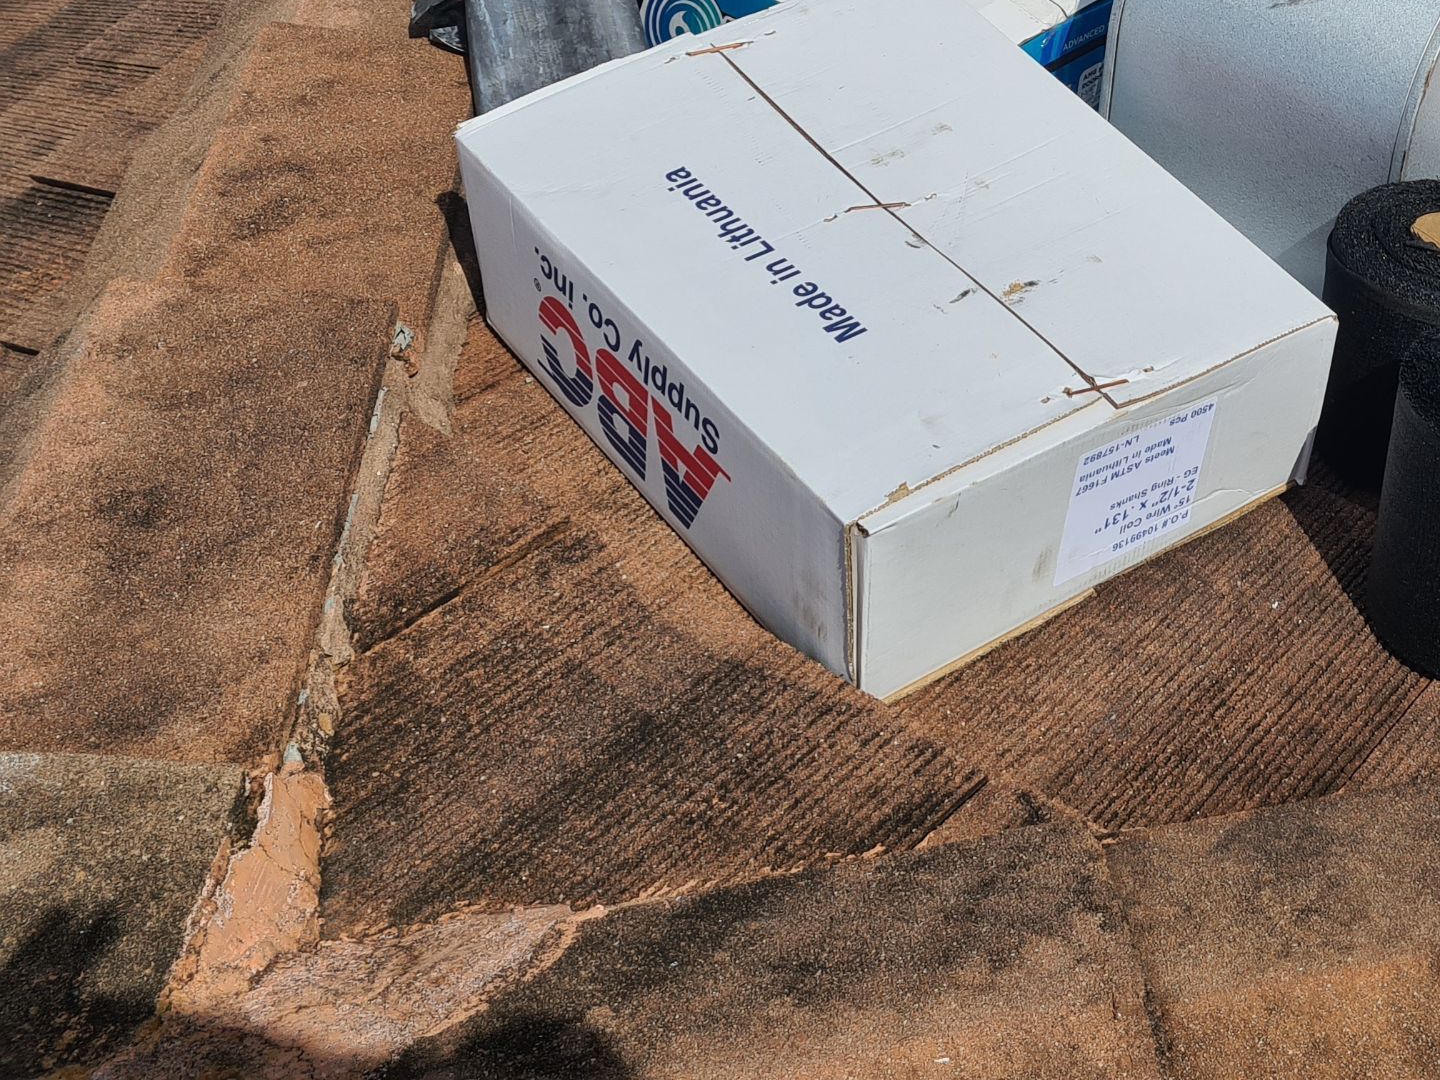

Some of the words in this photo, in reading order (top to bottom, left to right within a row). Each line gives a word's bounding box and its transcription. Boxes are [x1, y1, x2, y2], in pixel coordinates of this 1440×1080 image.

[1063, 24, 1105, 52] ADVANCED
[665, 166, 776, 262] Lithuania
[534, 246, 574, 310] inc.
[765, 257, 802, 286] in
[582, 294, 622, 353] Co.
[792, 281, 868, 344] Made
[628, 339, 721, 456] Supply
[536, 295, 732, 530] ABC
[1190, 402, 1215, 419] 4500
[1083, 434, 1140, 466] LN-157892
[1131, 450, 1142, 460] in
[1144, 436, 1173, 453] Made
[1145, 446, 1175, 463] Meets
[1079, 456, 1130, 483] Lithuania
[1110, 461, 1142, 482] ASTM
[1183, 466, 1199, 479] EG
[1075, 477, 1108, 497] F1667
[1151, 478, 1175, 492] Ring
[1110, 487, 1148, 510] Shanks
[1145, 503, 1172, 520] Wire
[1161, 509, 1189, 530] P.O.#
[1112, 524, 1160, 552] 10499136
[1119, 518, 1143, 535] Coil
